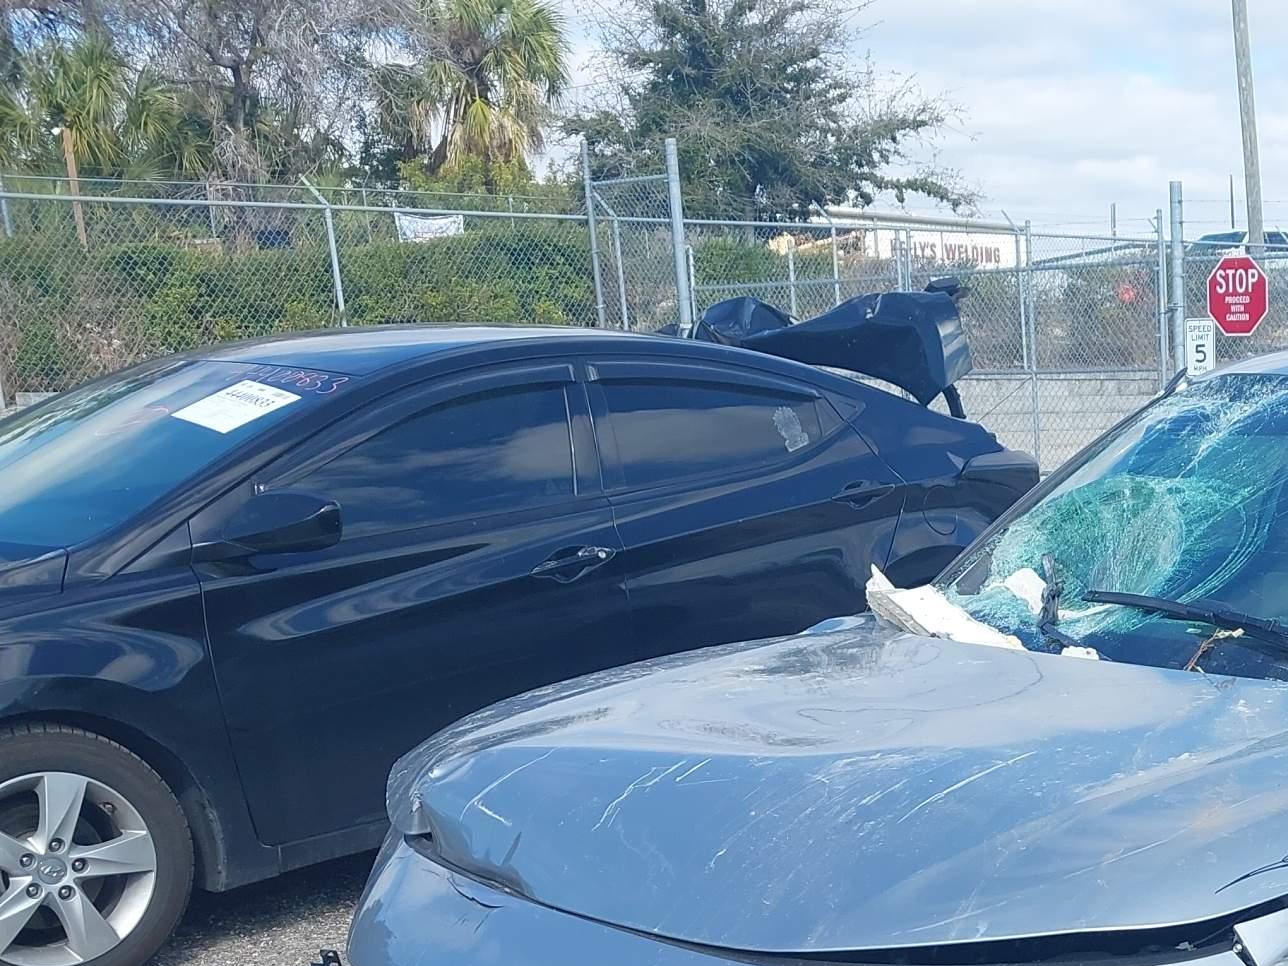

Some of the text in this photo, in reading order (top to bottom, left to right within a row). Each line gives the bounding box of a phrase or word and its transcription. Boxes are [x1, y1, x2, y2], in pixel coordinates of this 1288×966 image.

[891, 239, 1001, 263] KELY'S WELDING
[1215, 268, 1259, 294] STOP
[1224, 295, 1250, 304] PROCEED
[1230, 304, 1245, 313] WITH
[1225, 313, 1250, 321] CAUTION
[1188, 324, 1212, 333] SPEED
[1191, 333, 1210, 342] LIMIT
[1195, 343, 1207, 363] 5
[1193, 364, 1208, 372] MPH
